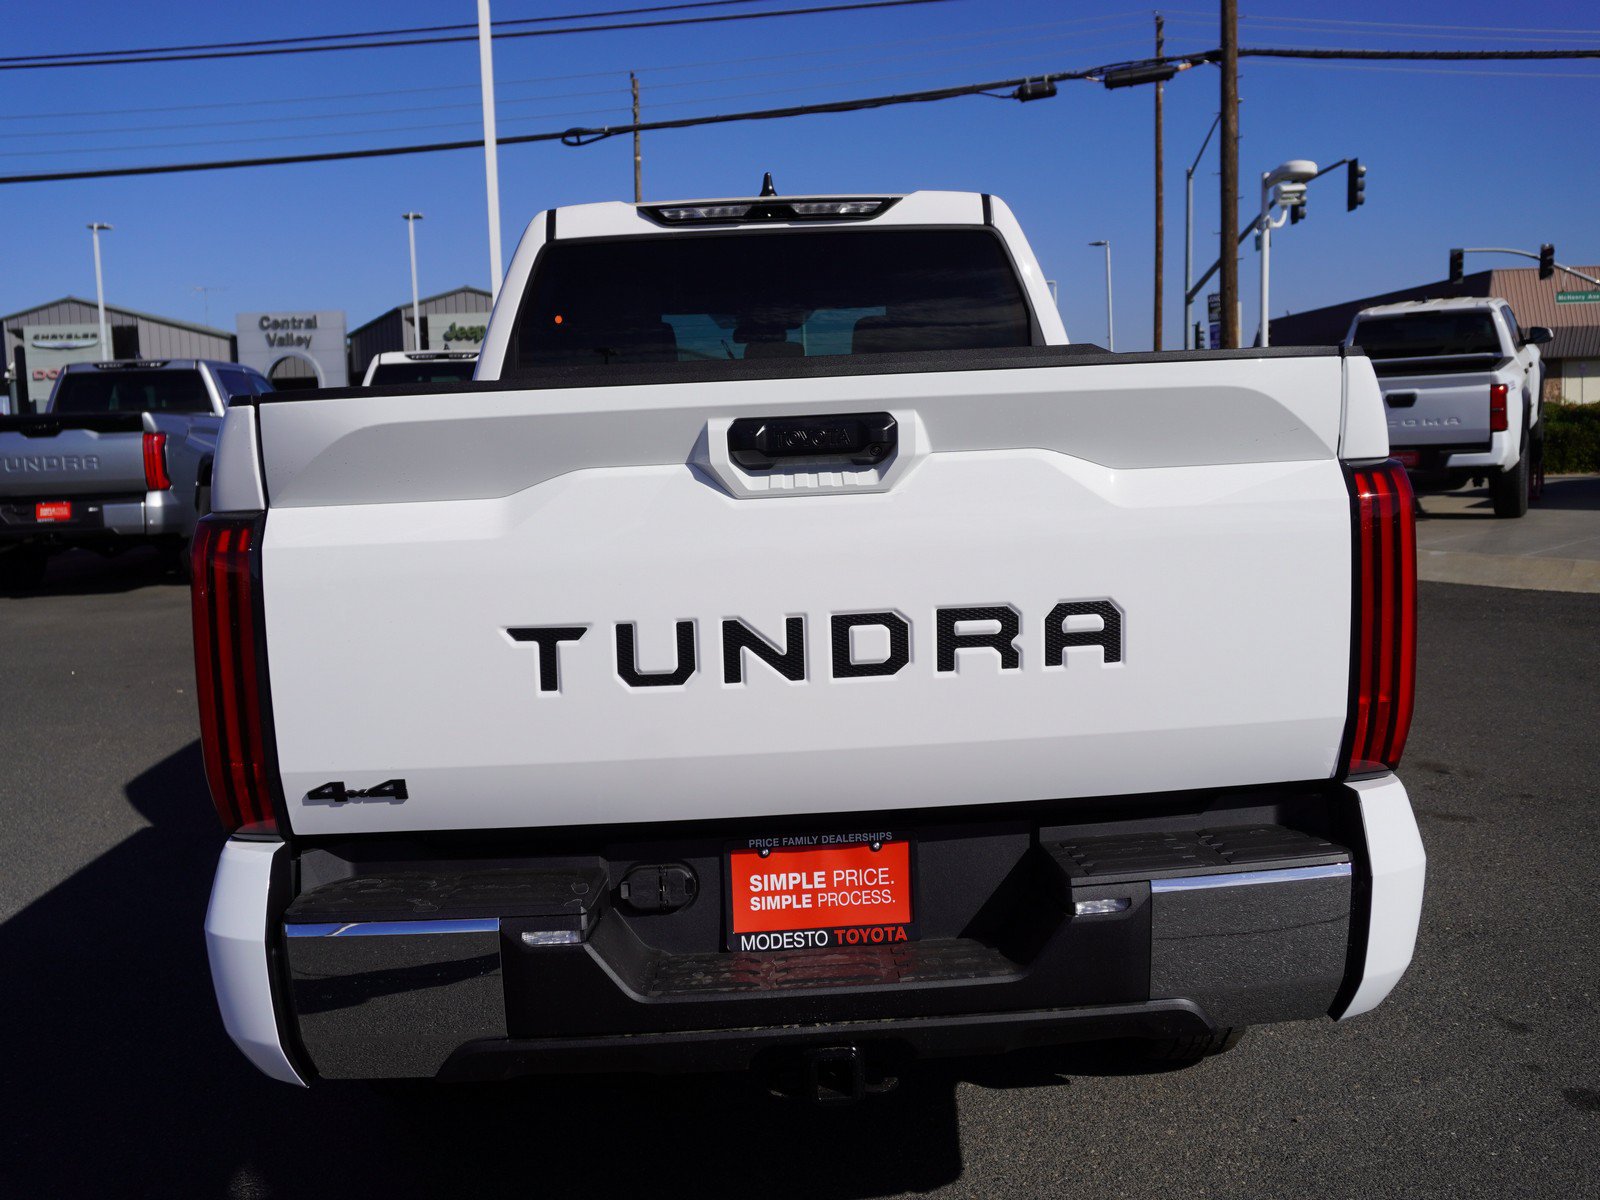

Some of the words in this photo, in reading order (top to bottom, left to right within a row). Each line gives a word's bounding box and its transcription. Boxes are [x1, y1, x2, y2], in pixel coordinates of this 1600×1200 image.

[258, 314, 318, 331] Central
[33, 333, 98, 341] CHRYSLER
[265, 332, 312, 349] Valley
[775, 428, 851, 449] TOYOTA
[503, 598, 1124, 693] TUNDRA
[749, 838, 779, 848] PRICE
[782, 835, 818, 846] FAMILY
[821, 831, 893, 845] DEALERSHIPS
[749, 871, 826, 892] SIMPLE
[833, 867, 895, 887] PRICE.
[750, 894, 812, 911] SIMPLE
[817, 889, 896, 908] PROCESS.
[741, 930, 829, 951] MODESTO
[834, 926, 908, 945] TOYOTA
